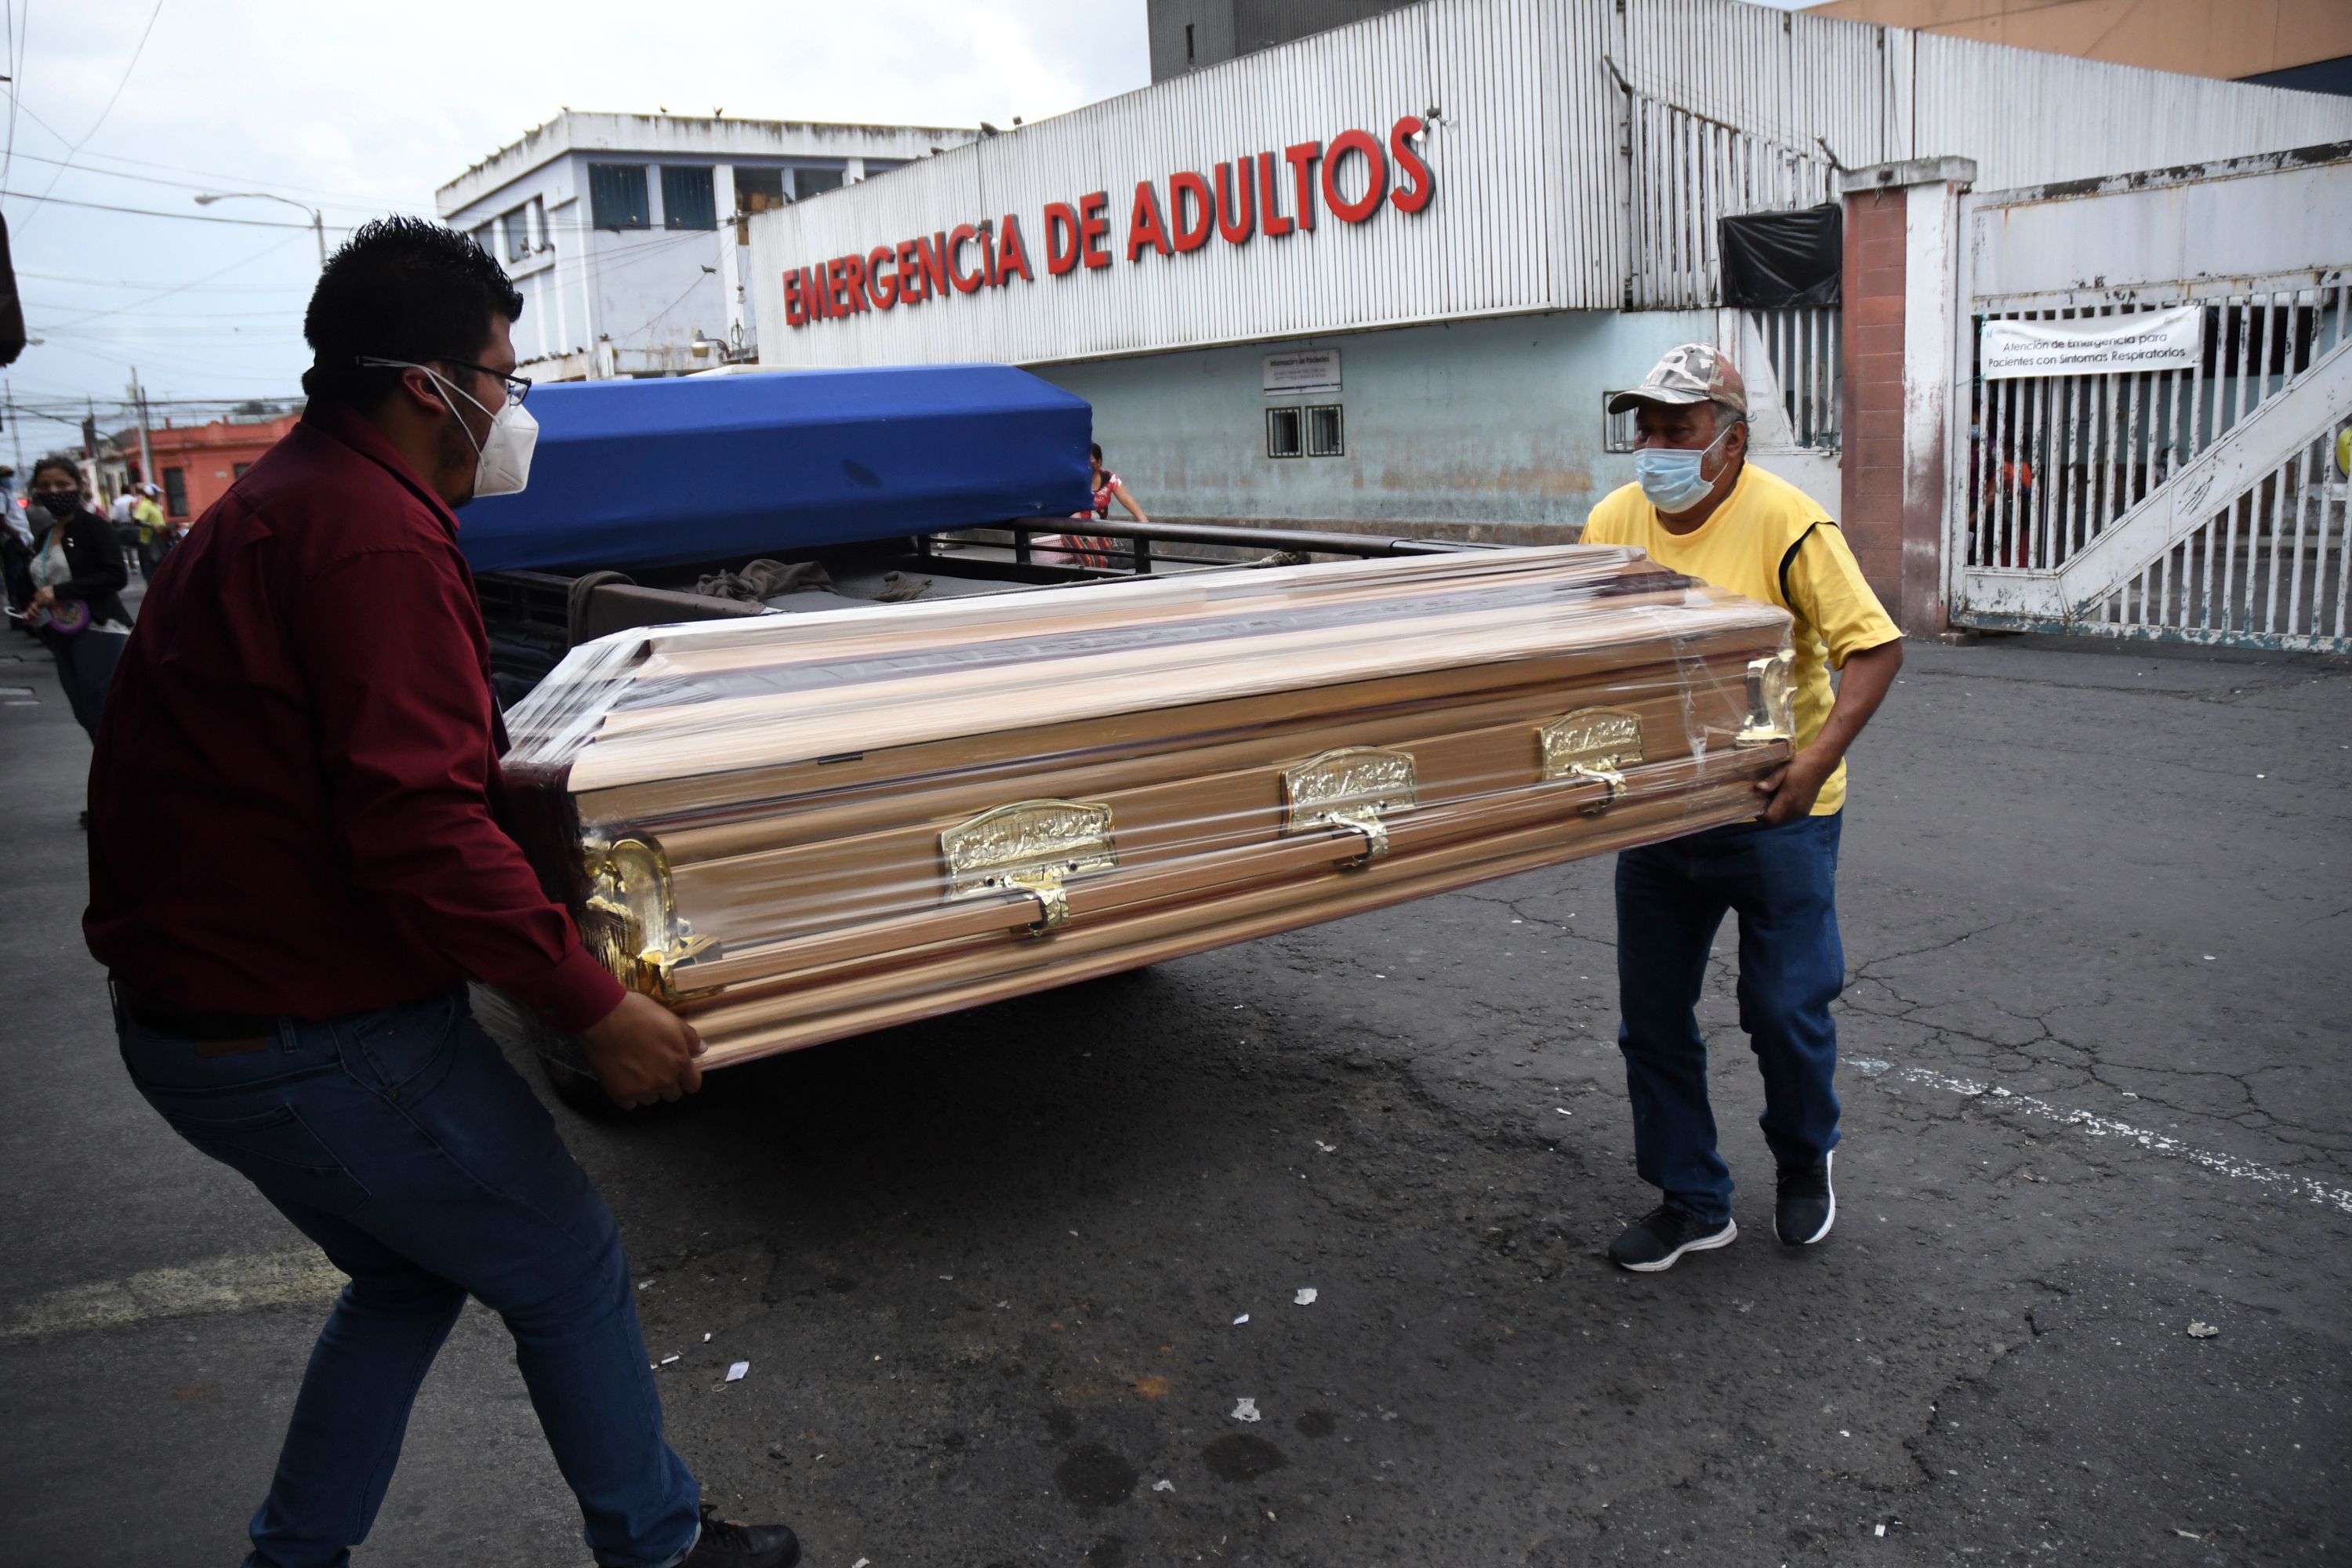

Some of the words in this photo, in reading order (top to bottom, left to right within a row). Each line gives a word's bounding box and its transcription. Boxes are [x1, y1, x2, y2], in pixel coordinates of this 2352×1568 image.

[782, 213, 1033, 326] EMERGENCIA
[1044, 191, 1112, 275] DE
[1127, 114, 1436, 261] ADULTOS
[2003, 337, 2049, 352] Atención
[2051, 340, 2064, 349] de
[2067, 333, 2135, 348] Emergencia
[2139, 332, 2167, 346] para
[1988, 357, 2033, 368] Pacientes
[2036, 357, 2056, 365] con
[2111, 347, 2186, 363] Respiratorios
